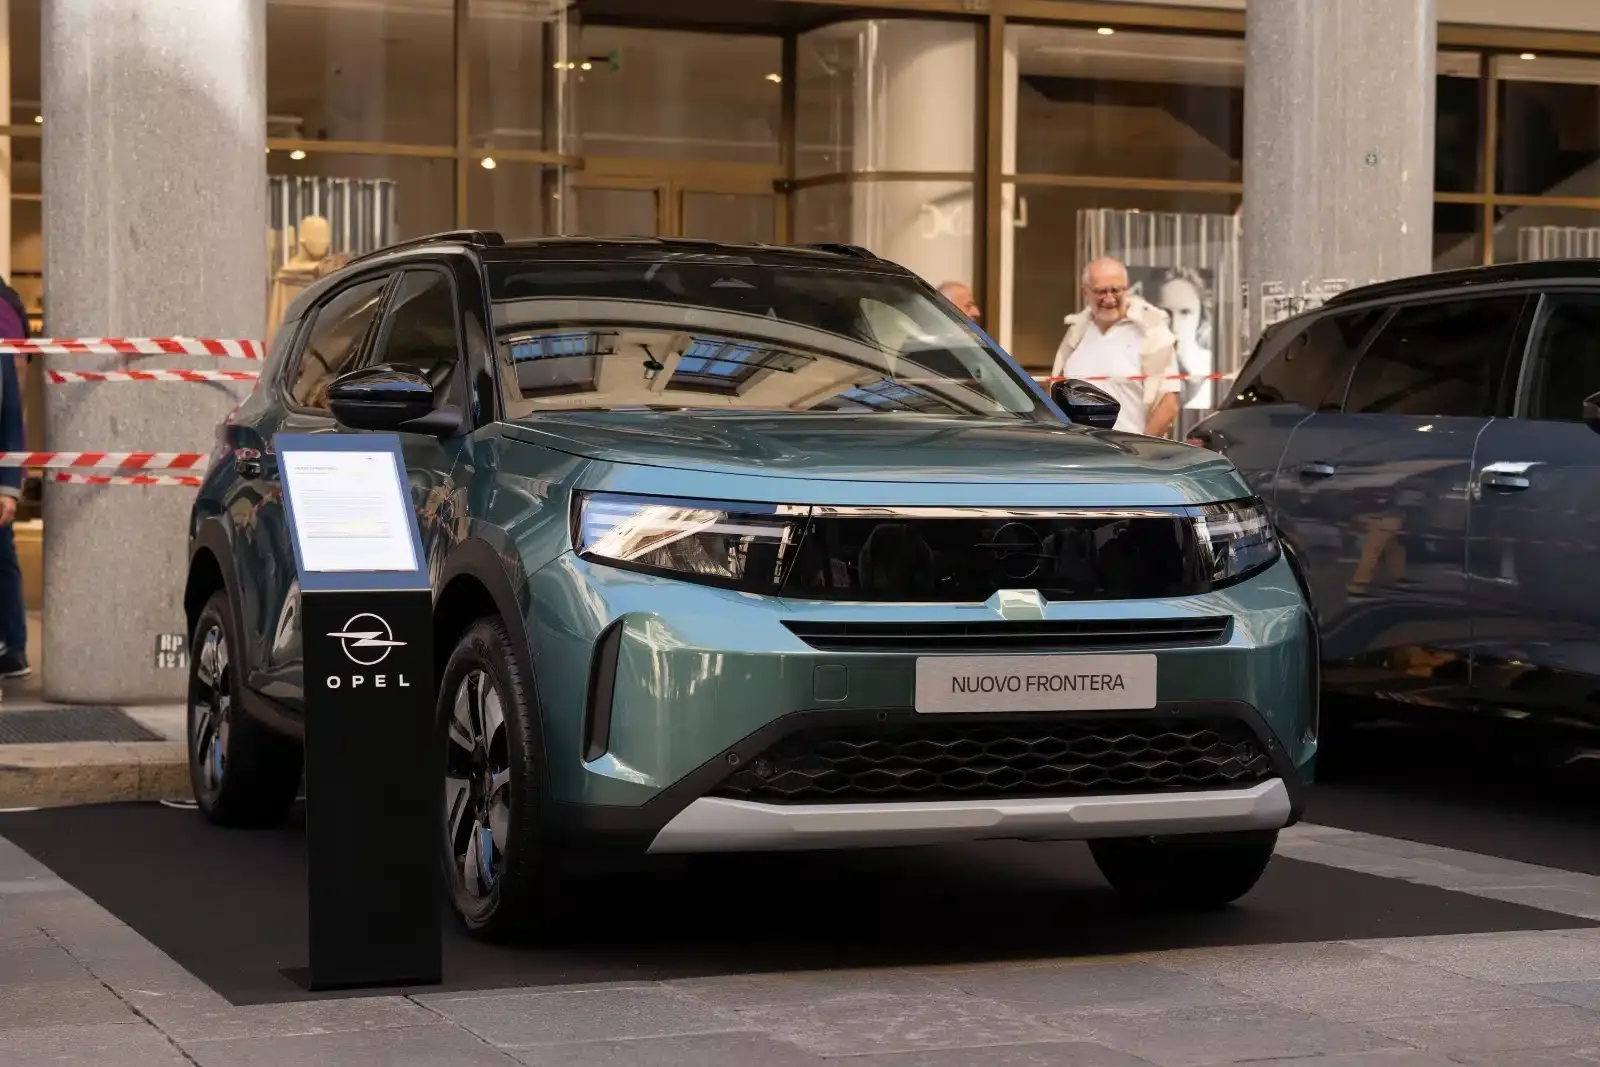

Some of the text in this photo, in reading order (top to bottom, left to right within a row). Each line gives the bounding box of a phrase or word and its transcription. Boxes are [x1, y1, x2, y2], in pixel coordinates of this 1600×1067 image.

[326, 674, 410, 689] OPEL
[952, 674, 1125, 693] NUOVO FRONTERA
